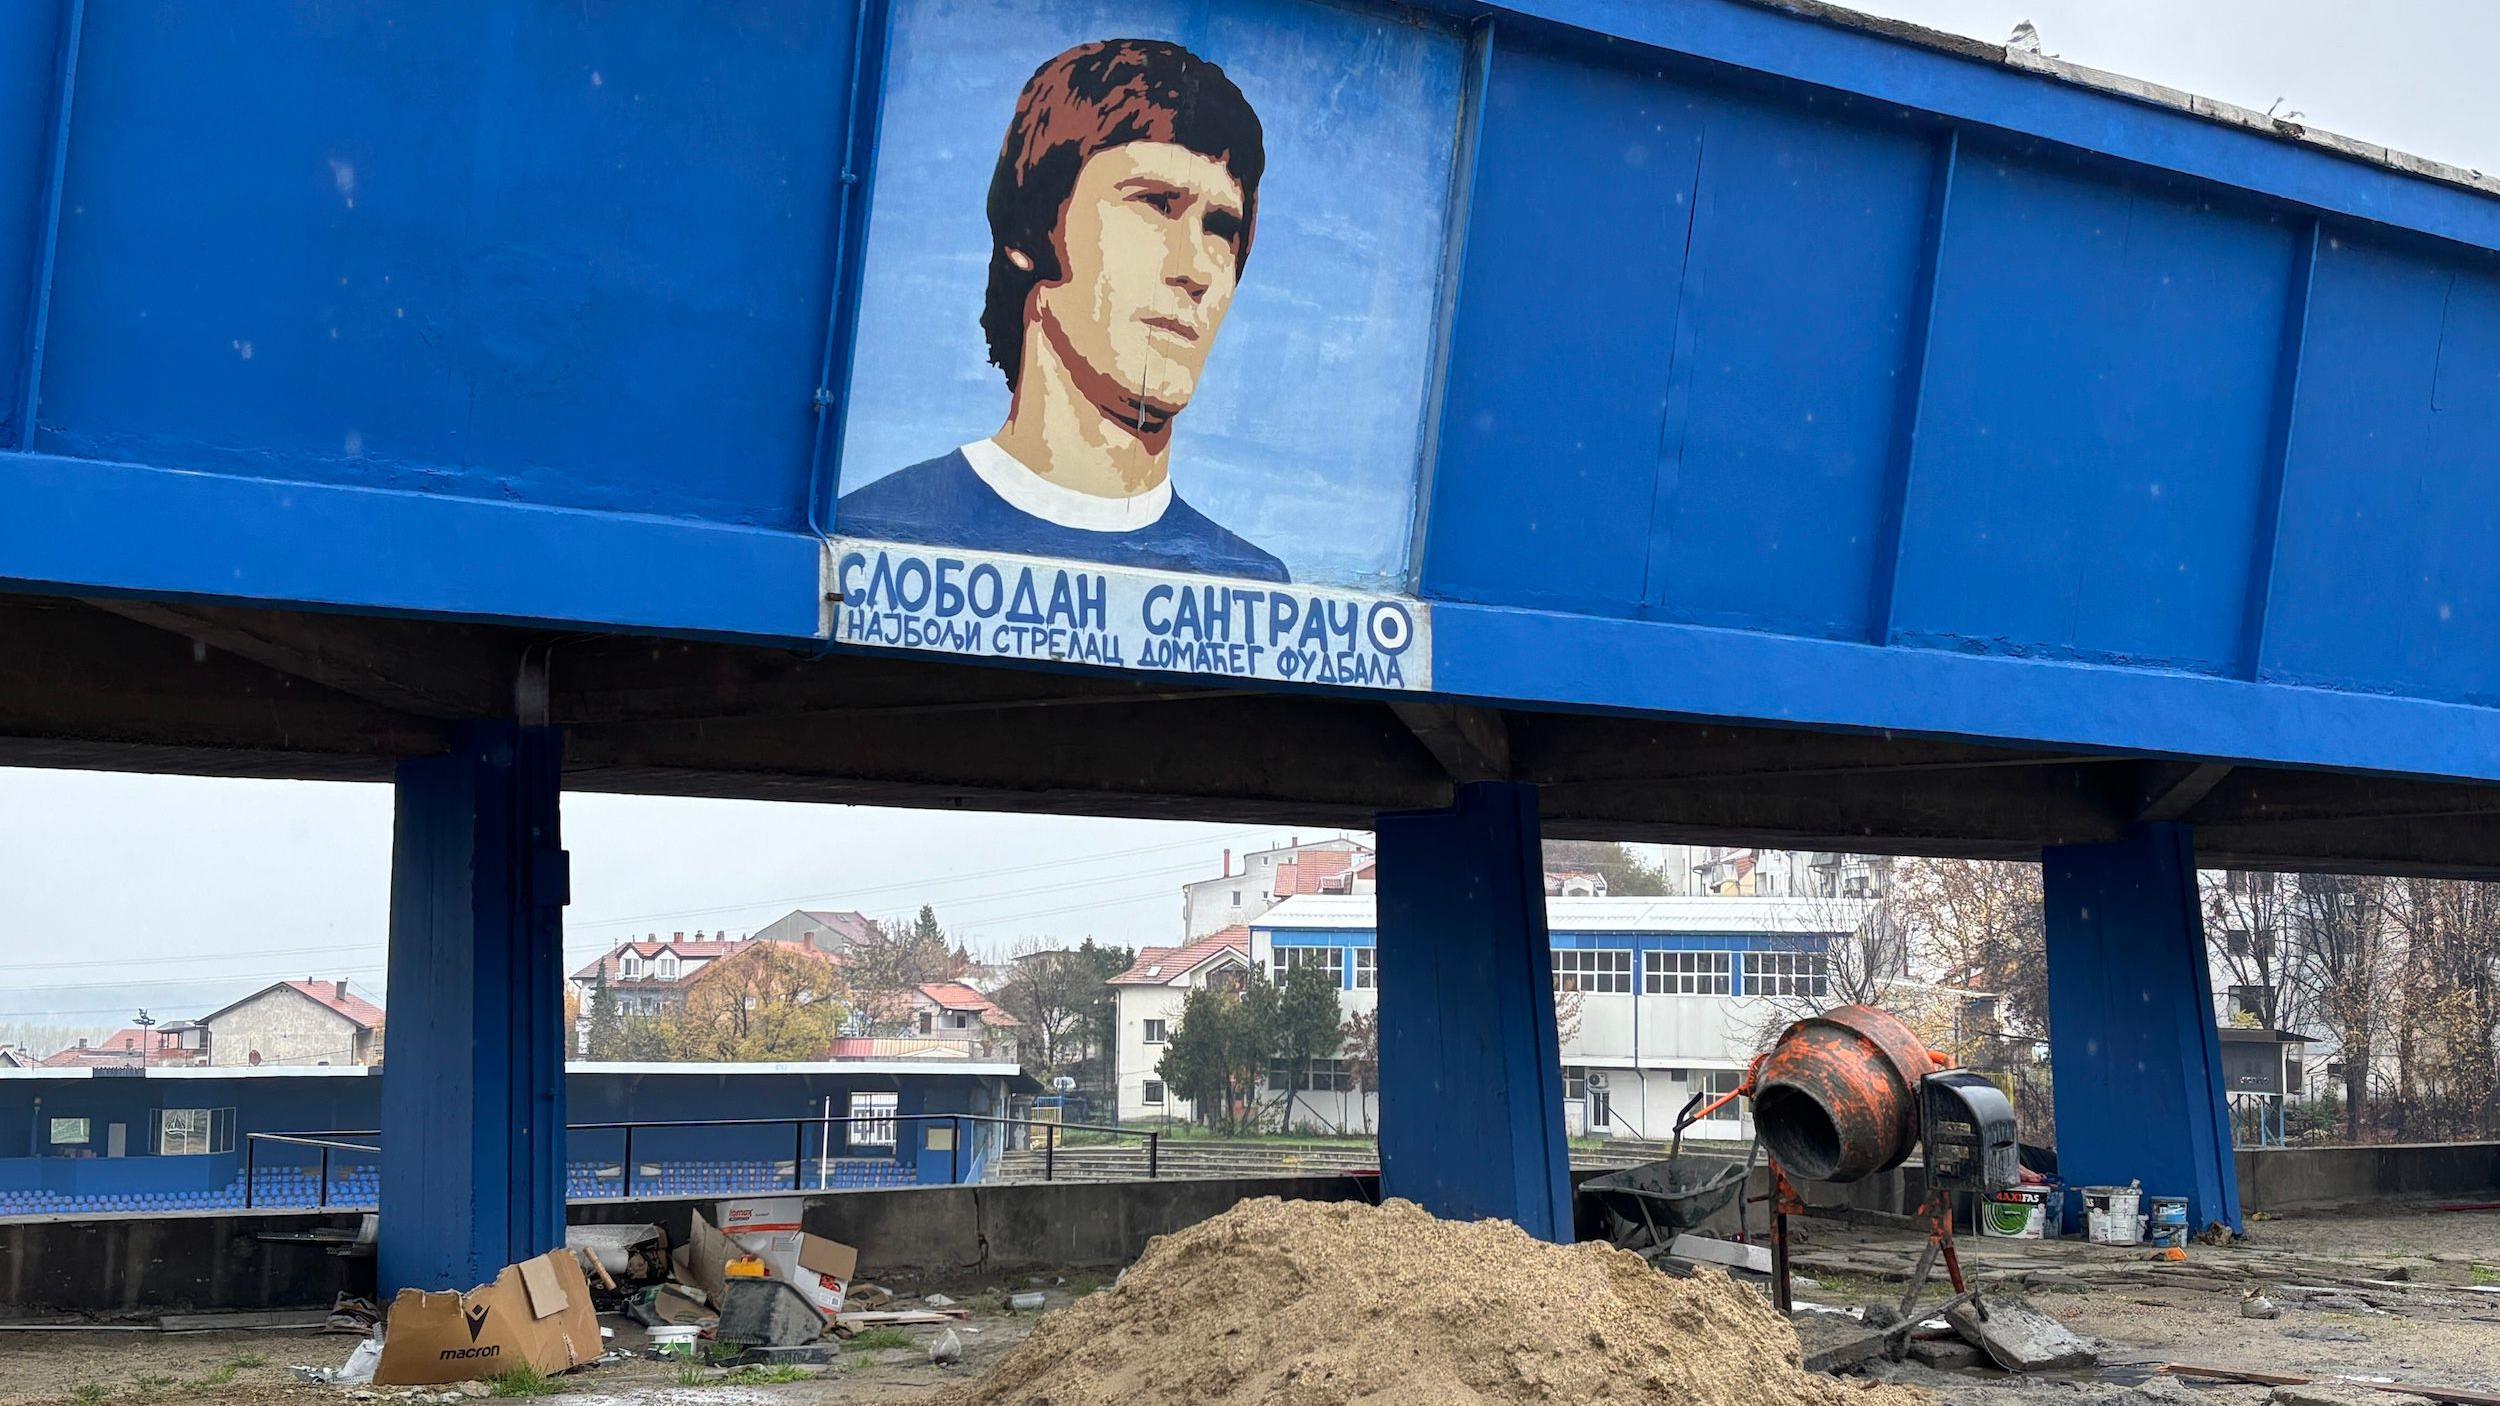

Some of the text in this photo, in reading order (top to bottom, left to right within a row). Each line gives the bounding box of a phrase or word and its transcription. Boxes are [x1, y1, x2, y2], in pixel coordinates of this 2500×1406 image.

[838, 551, 1358, 651] СЛОБОДАН САНТРАЧ
[847, 608, 1405, 688] НАЈБОЉИ СТРЕЛАЦ ДОМАЋЕГ ФУДБАЛА
[440, 1345, 500, 1360] macron
